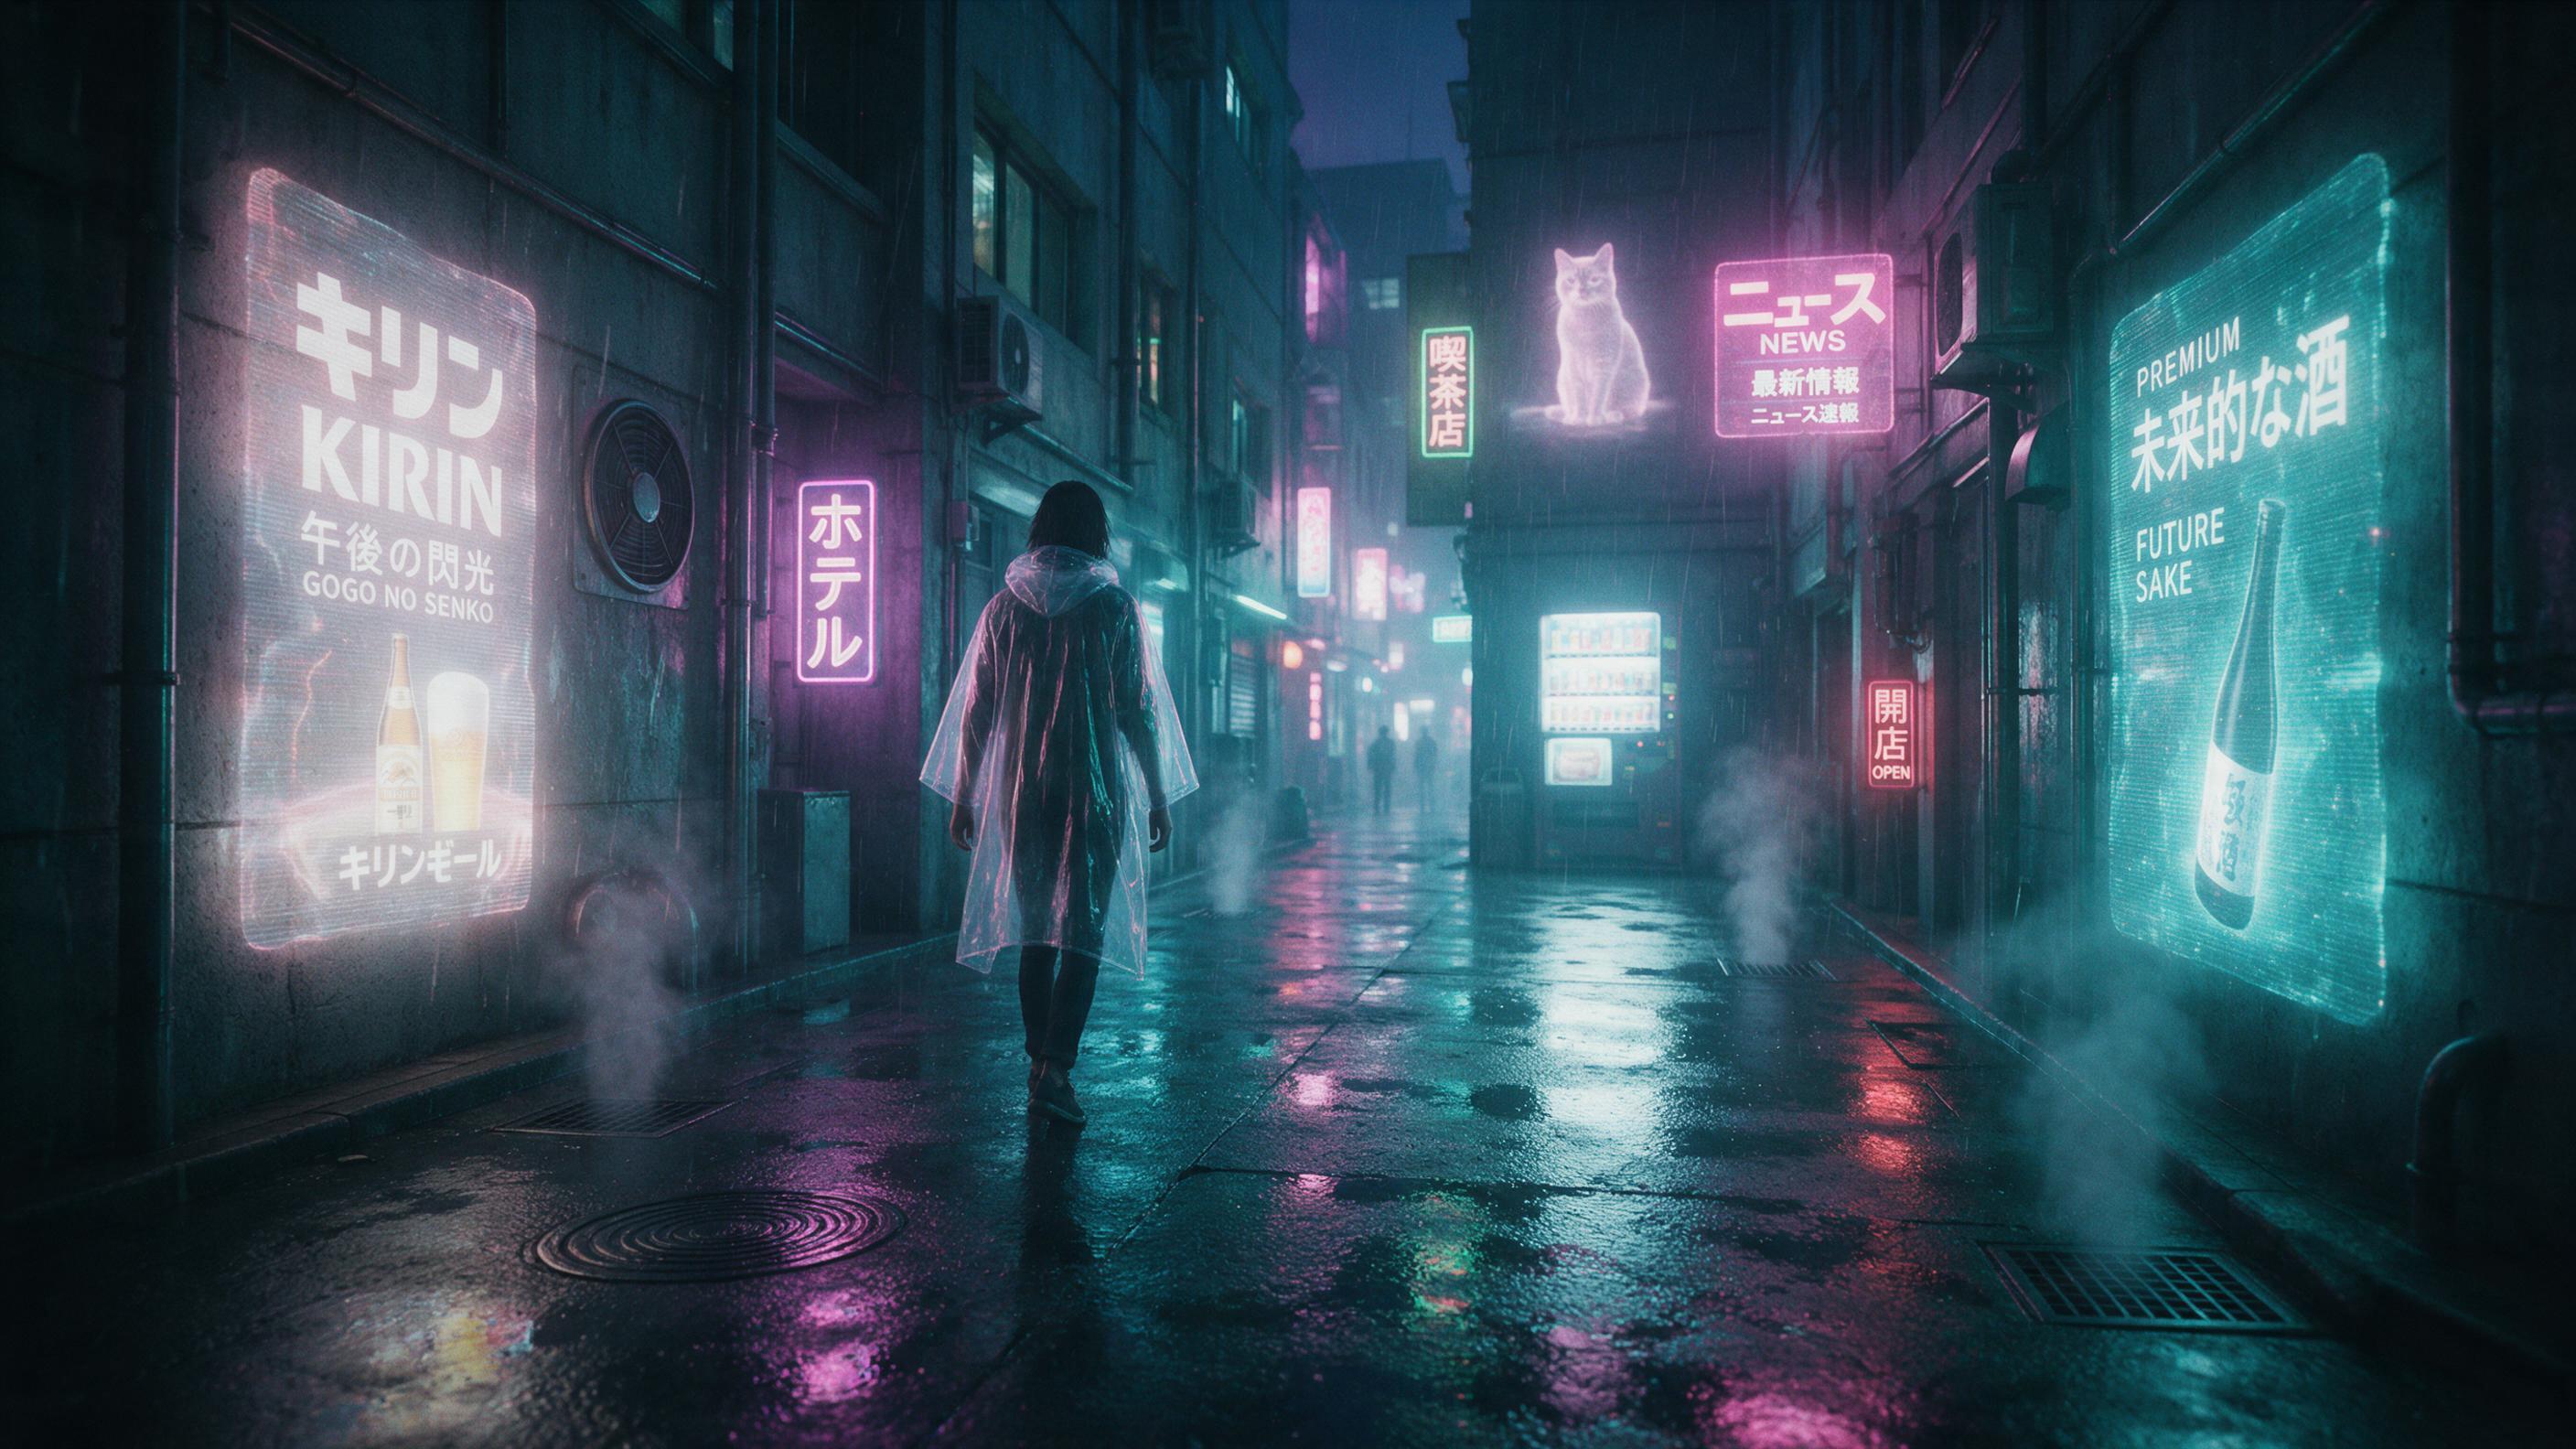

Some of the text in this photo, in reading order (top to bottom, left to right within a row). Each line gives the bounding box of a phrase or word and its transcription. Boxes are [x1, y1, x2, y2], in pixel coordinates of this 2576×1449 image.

[1723, 272, 1886, 327] ニュース
[297, 271, 503, 439] キリン
[1760, 329, 1846, 355] NEWS
[2137, 317, 2239, 398] PREMIUM
[1429, 335, 1466, 448] 喫茶店
[1751, 366, 1860, 397] 最新情報
[1751, 402, 1860, 424] ニュース速報
[2131, 314, 2349, 493] 未来的な酒
[302, 403, 502, 538] KIRIN
[301, 510, 495, 596] 午後の閃光
[2137, 507, 2225, 562] FUTURE
[302, 570, 494, 624] GOGO NO SENKO
[807, 493, 864, 670] ホテル
[2136, 560, 2193, 603] SAKE
[1873, 689, 1908, 761] 開店
[1872, 765, 1911, 779] OPEN
